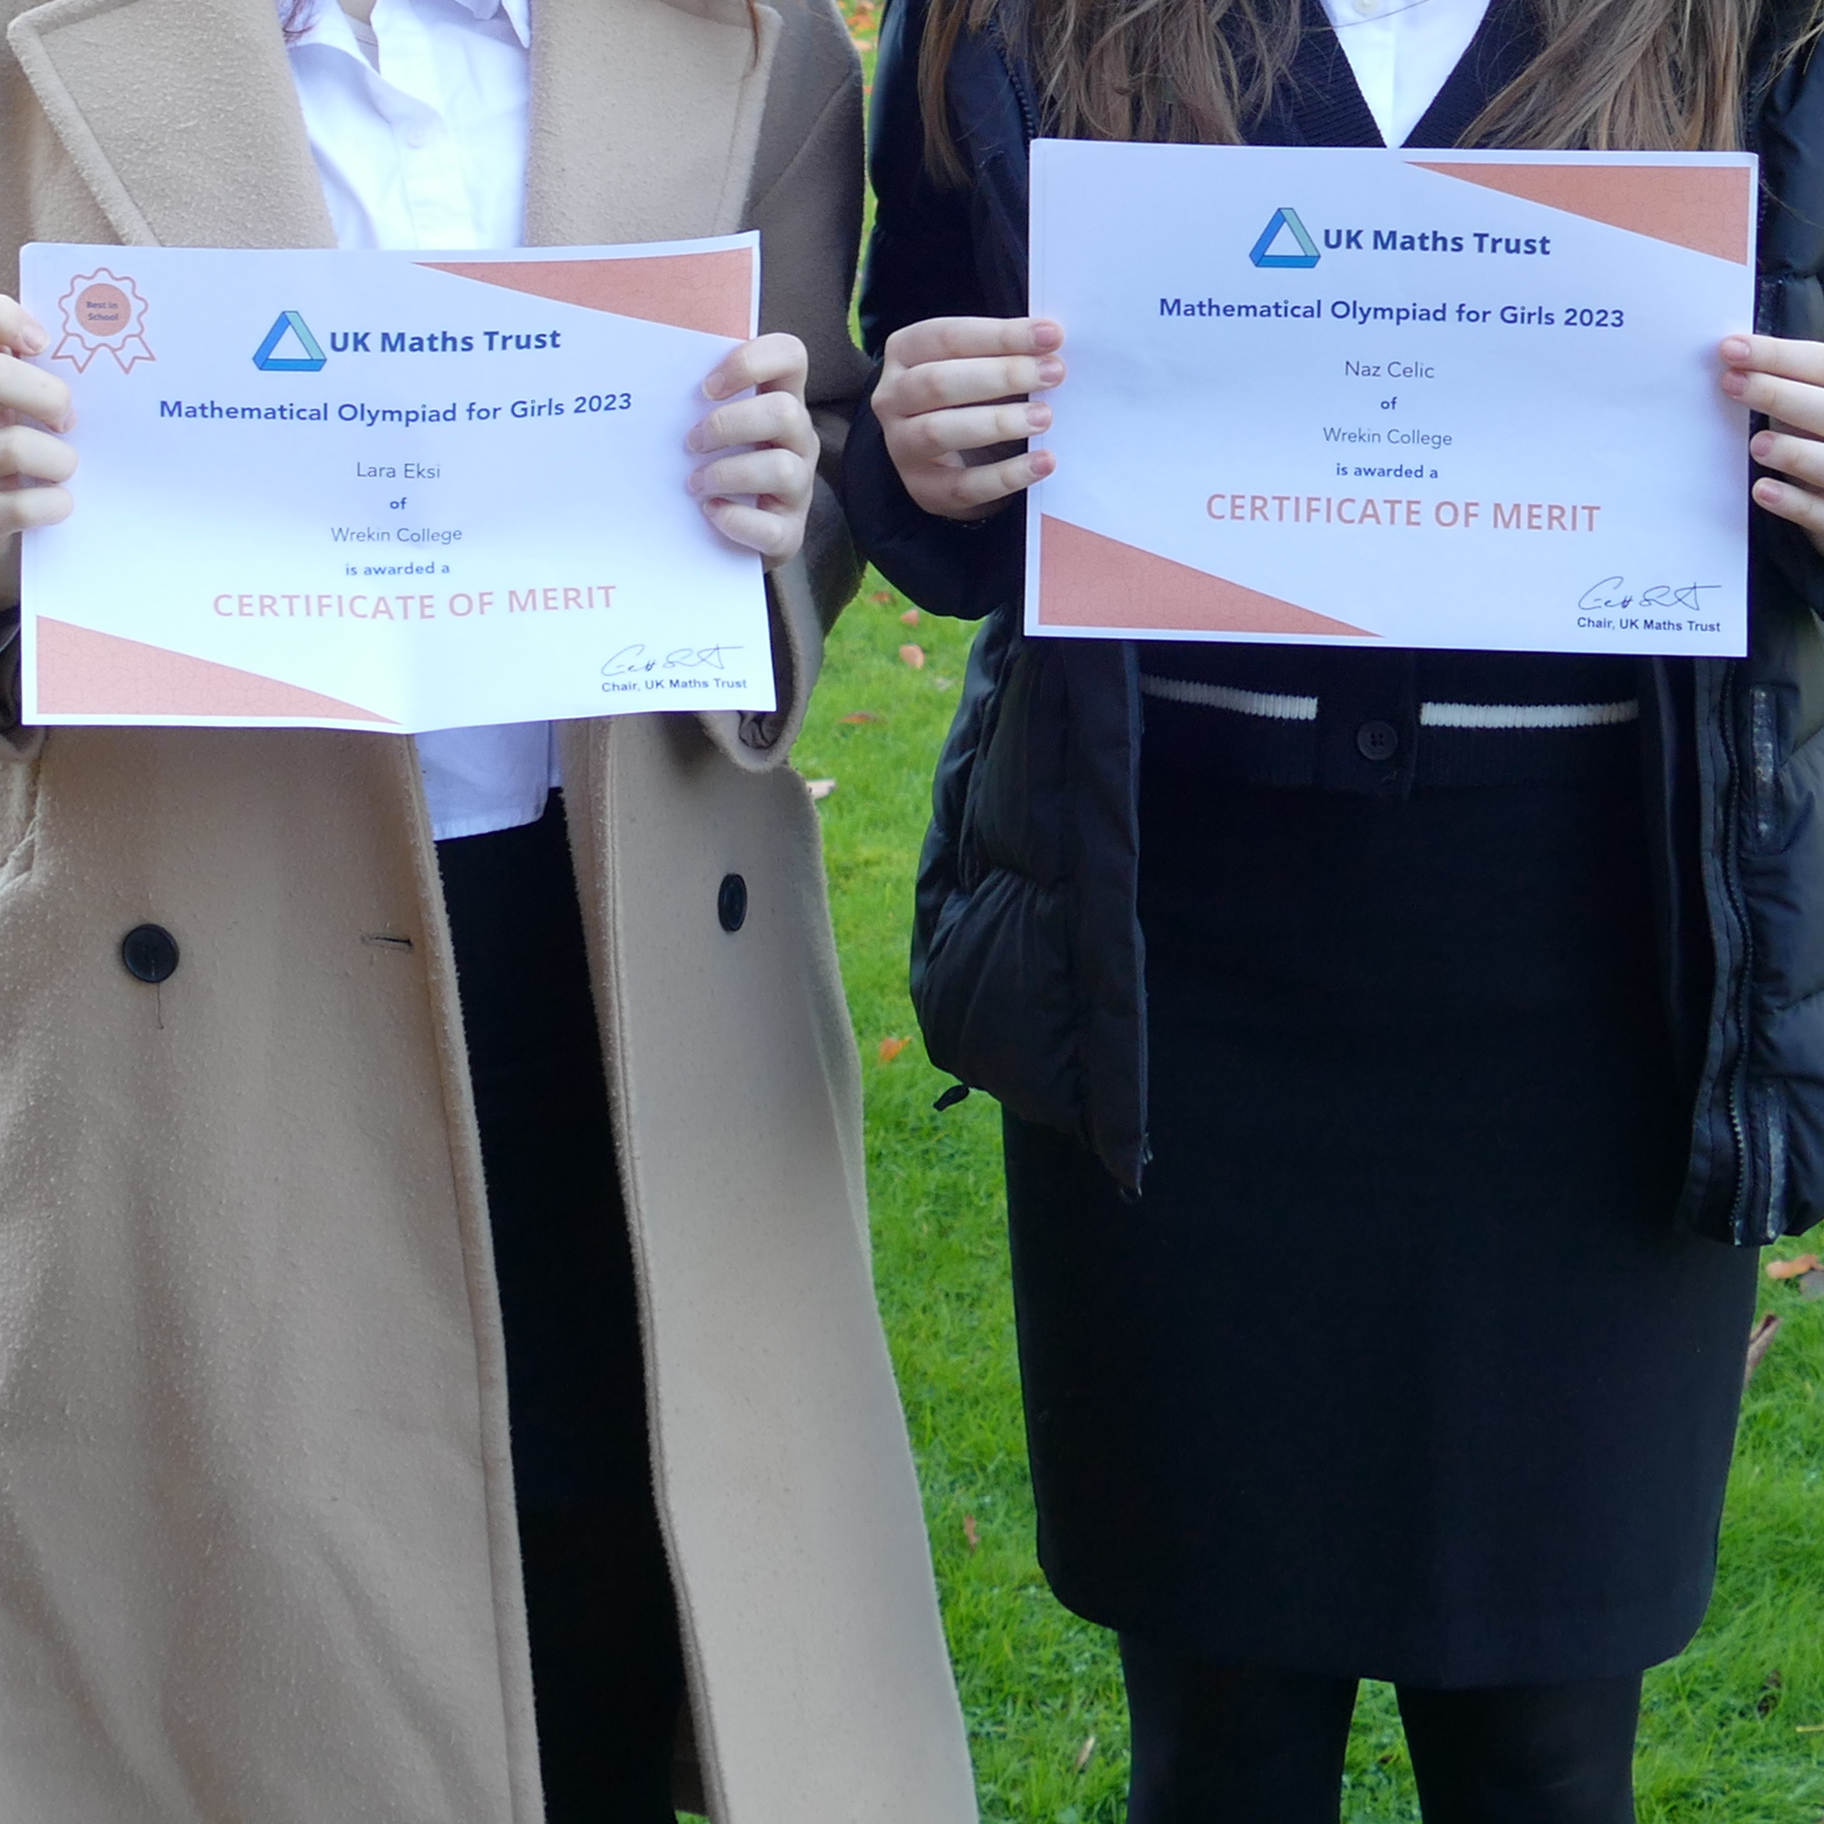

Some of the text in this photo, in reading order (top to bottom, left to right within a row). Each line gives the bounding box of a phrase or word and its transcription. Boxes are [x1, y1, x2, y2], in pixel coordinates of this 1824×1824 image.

[1323, 228, 1551, 256] UK Maths Trust
[86, 301, 107, 309] Best
[1159, 297, 1625, 328] Mathematical Olympiad for Girls 2023
[87, 313, 119, 321] School
[330, 329, 562, 353] UK Maths Trust
[1344, 360, 1435, 379] Naz Celic
[159, 392, 632, 428] Mathematical Olympiad for Girls 2023
[1380, 396, 1398, 411] of
[1322, 426, 1453, 450] Wrekin College
[356, 461, 441, 480] Lara Eksi
[1336, 462, 1439, 479] is awarded a
[389, 496, 408, 510] of
[1206, 493, 1602, 532] CERTIFICATE OF MERIT
[330, 525, 463, 546] Wrekin College
[345, 561, 451, 577] is awarded a
[212, 584, 617, 621] CERTIFICATE OF MERIT
[1576, 616, 1721, 633] Chair, UK Maths Trust
[601, 677, 747, 693] Chair, UK Maths Trust
